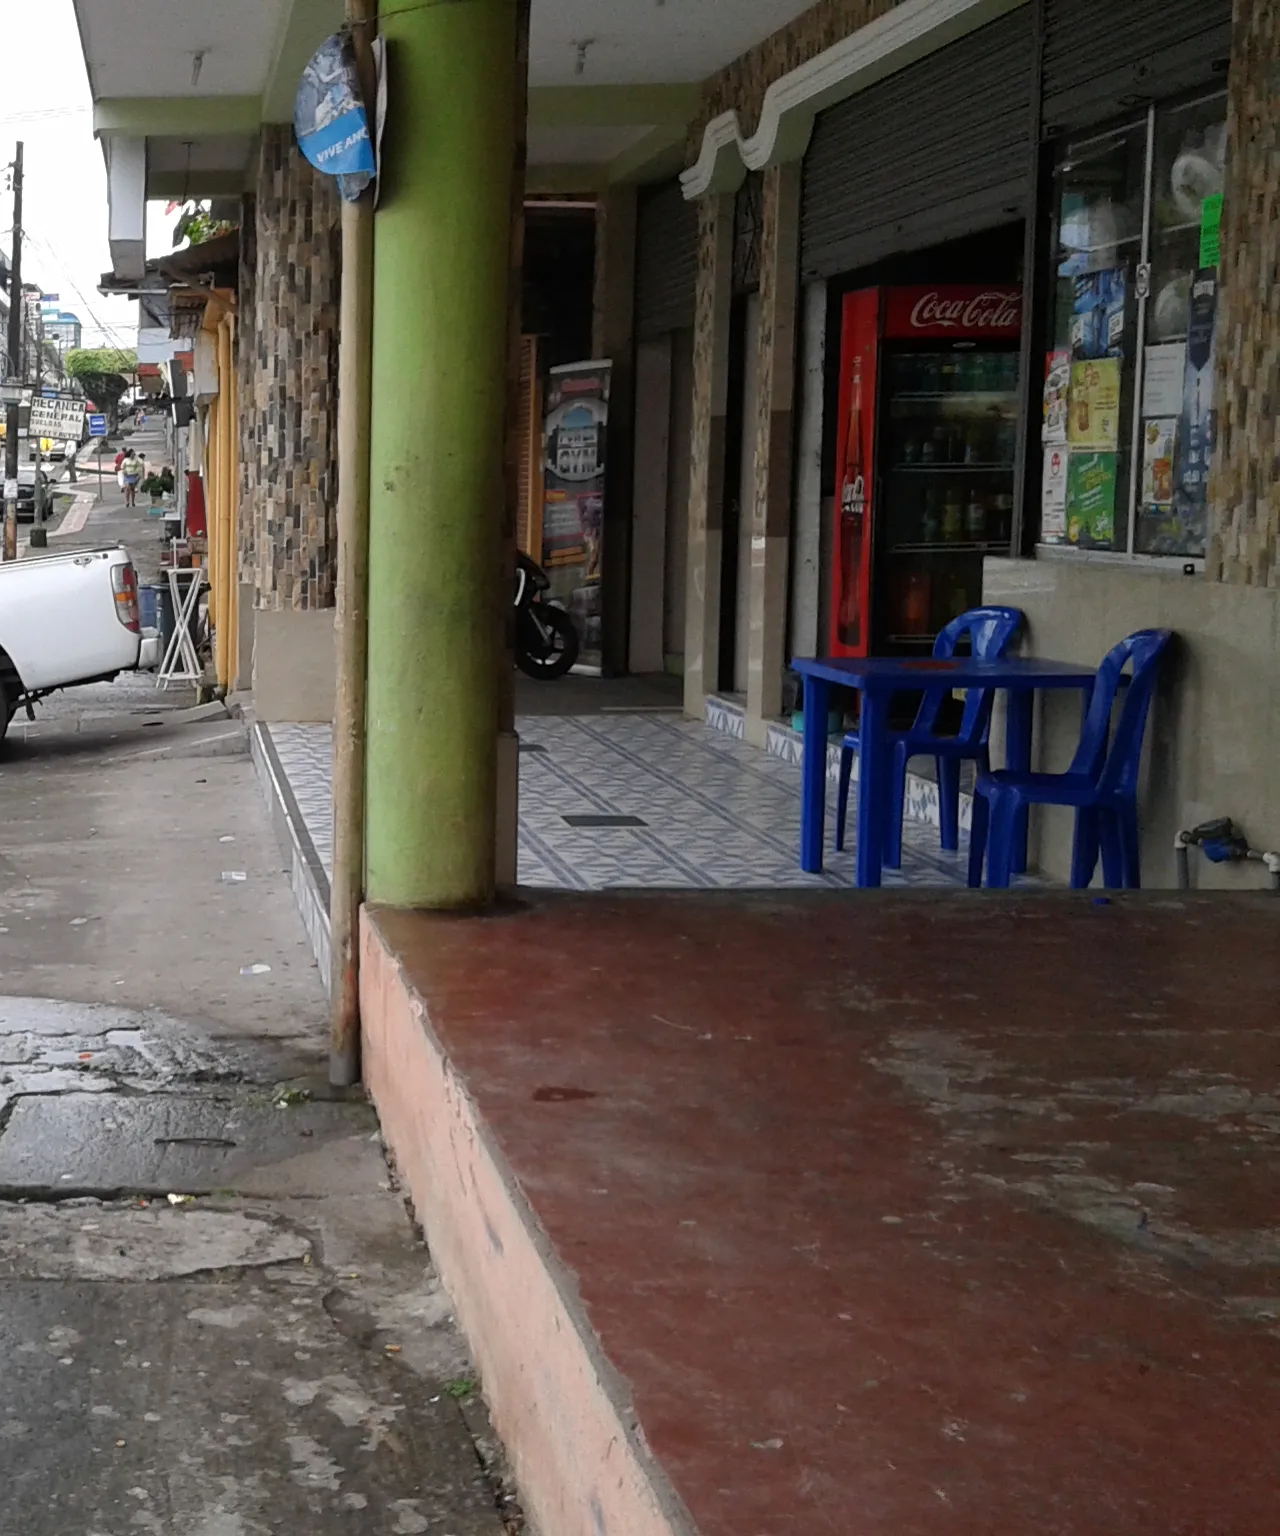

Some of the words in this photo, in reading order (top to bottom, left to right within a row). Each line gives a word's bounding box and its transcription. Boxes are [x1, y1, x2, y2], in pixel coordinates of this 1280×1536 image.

[316, 141, 344, 162] VIVE
[910, 292, 1021, 327] Coca-Cola
[31, 410, 81, 422] GENERAL
